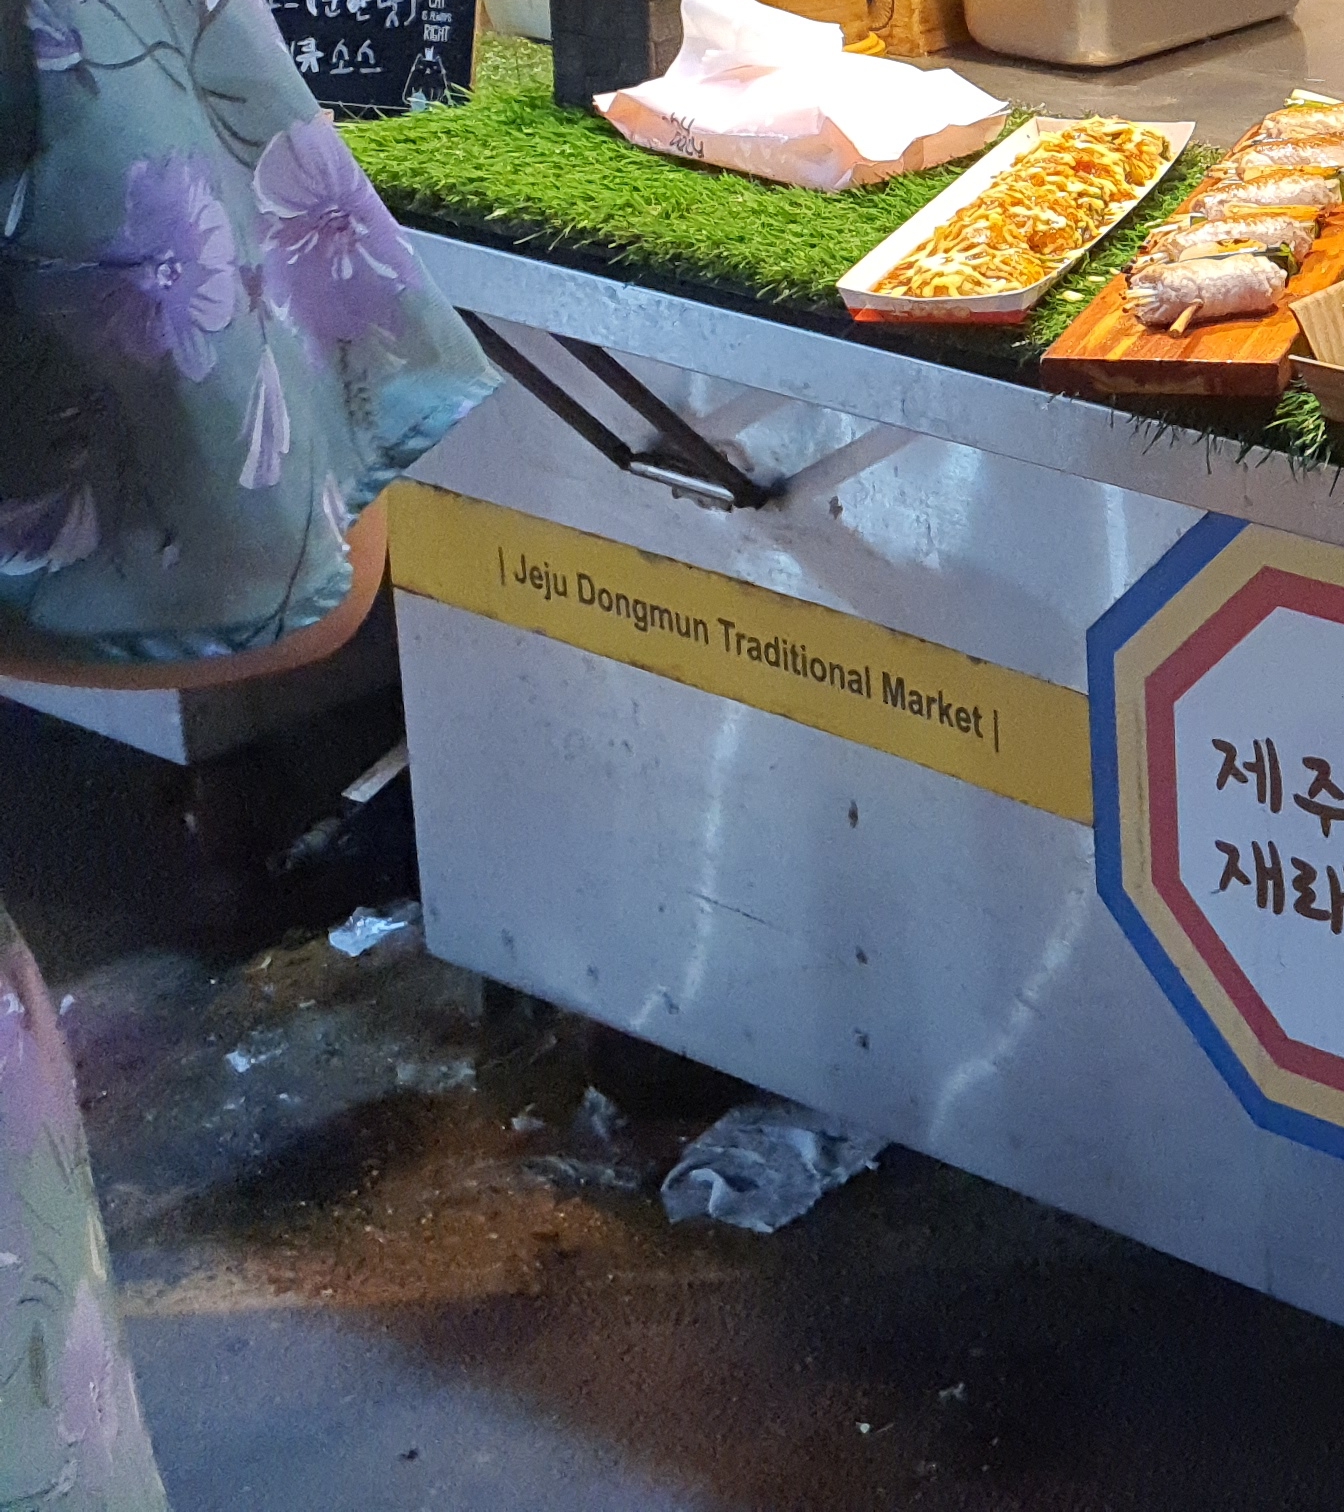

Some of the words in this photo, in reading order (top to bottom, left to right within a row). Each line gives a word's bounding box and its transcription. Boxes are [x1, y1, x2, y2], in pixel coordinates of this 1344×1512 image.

[514, 553, 569, 601] Jeju
[576, 573, 710, 645] Dongmun
[716, 617, 872, 699] Traditional
[881, 670, 984, 740] Market
